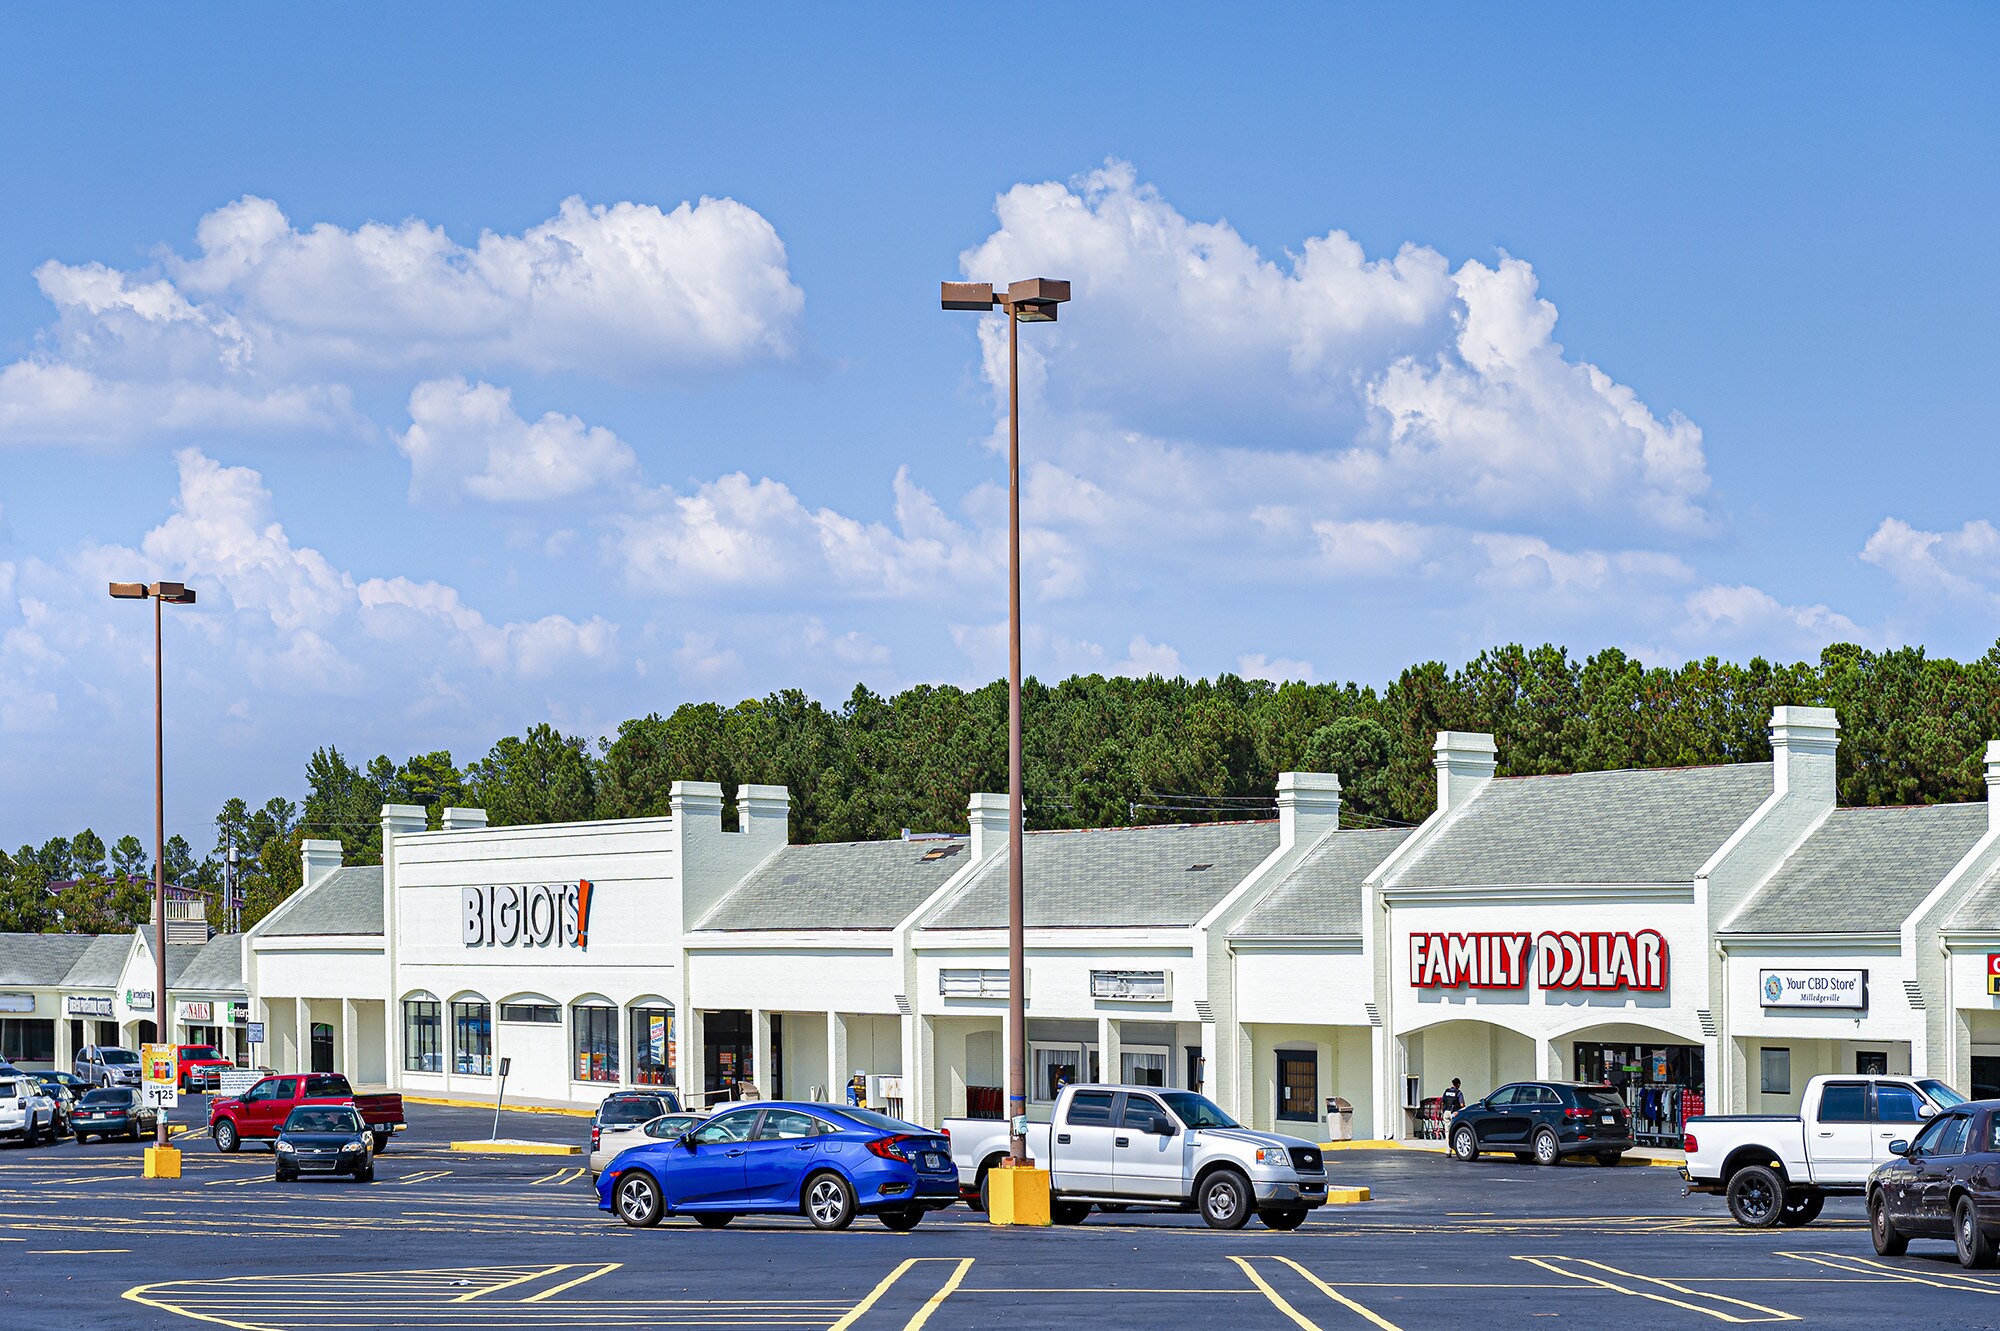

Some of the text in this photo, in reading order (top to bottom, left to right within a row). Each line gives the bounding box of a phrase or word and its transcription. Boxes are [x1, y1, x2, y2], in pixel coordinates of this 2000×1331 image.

[1410, 929, 1665, 990] FAMILY DOLLAR
[1786, 977, 1806, 990] Your
[1808, 977, 1828, 990] CBD
[1800, 993, 1840, 1003] Milledgeville
[188, 1003, 208, 1018] NAILS
